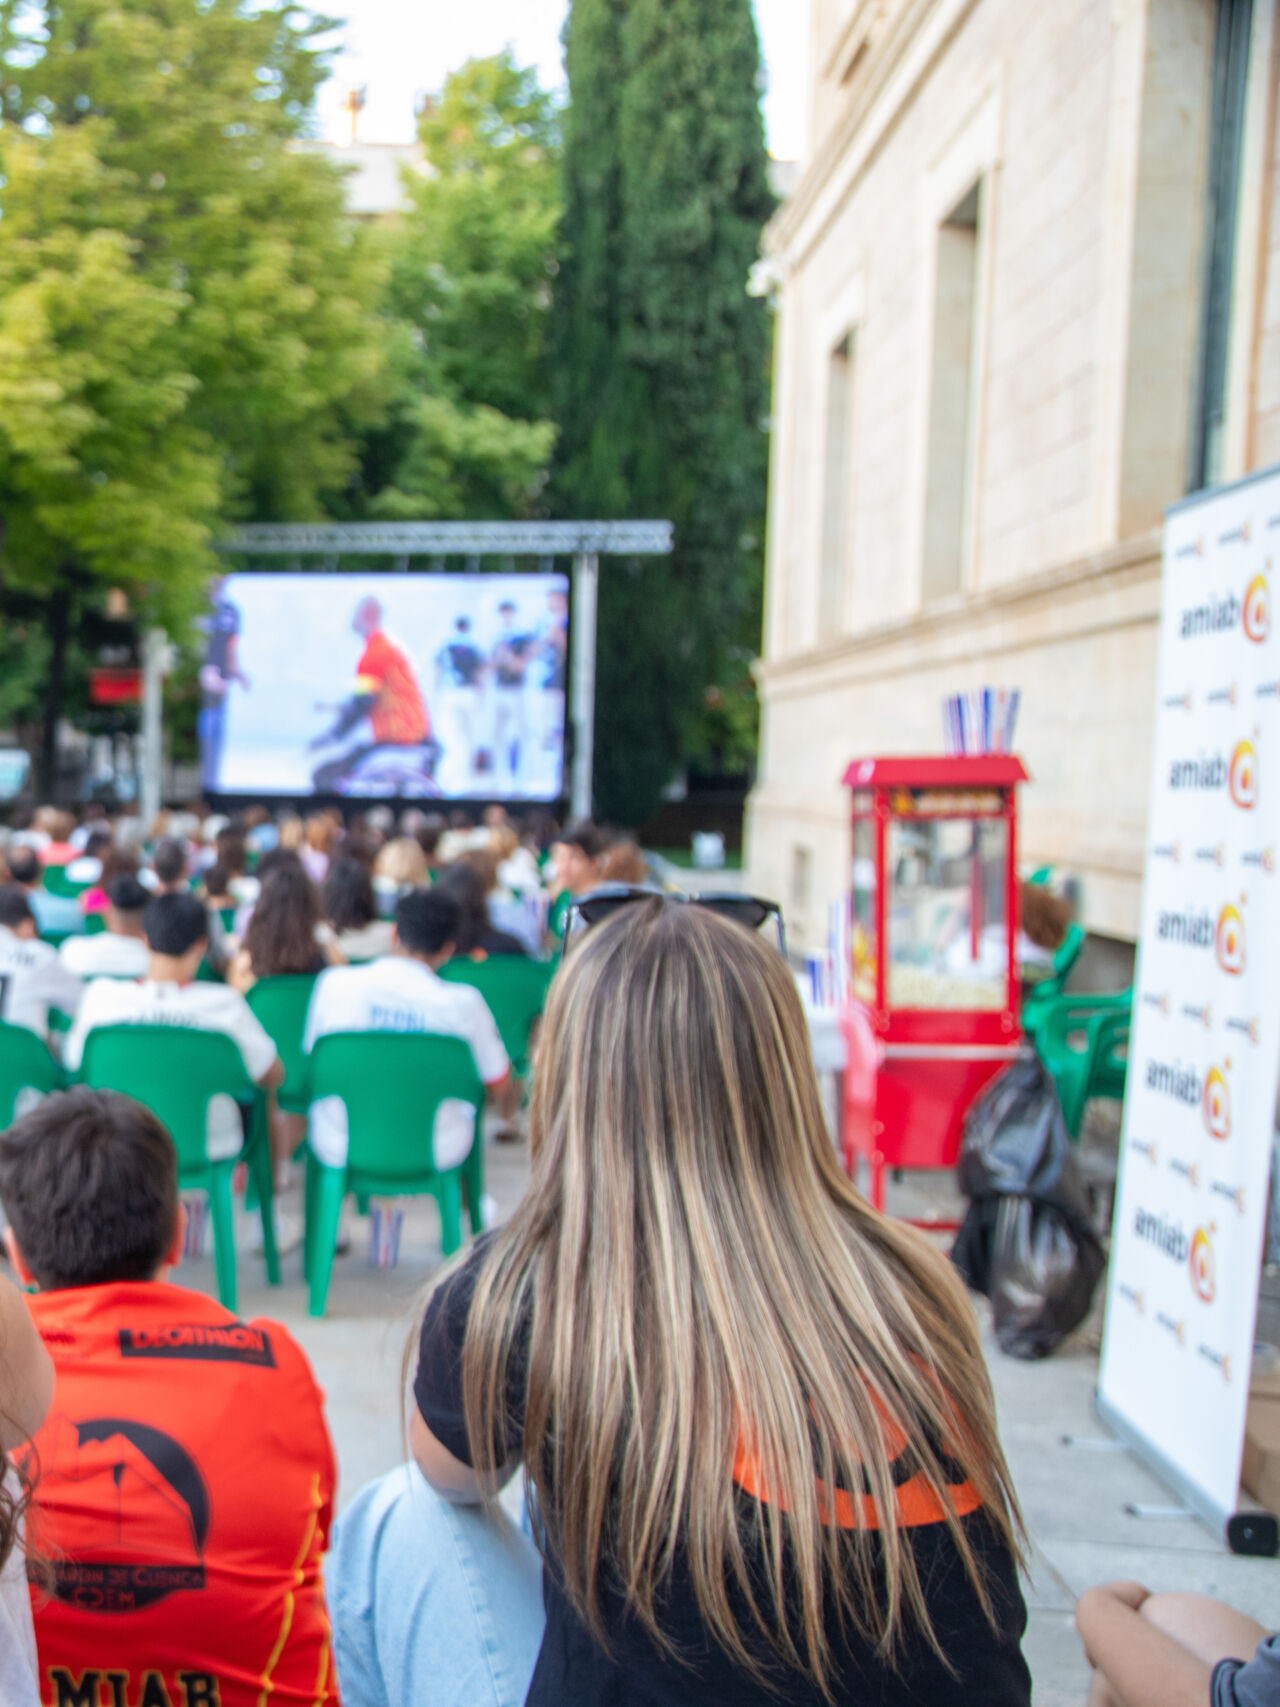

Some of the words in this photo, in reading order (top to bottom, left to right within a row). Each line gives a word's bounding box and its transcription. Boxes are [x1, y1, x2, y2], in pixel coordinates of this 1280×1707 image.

[1181, 591, 1238, 638] amiab
[1169, 748, 1228, 790] amiab
[1158, 904, 1214, 946] amiab
[1146, 1058, 1202, 1106] amiab
[1134, 1208, 1189, 1263] amiab
[132, 1326, 266, 1352] DECATHLON
